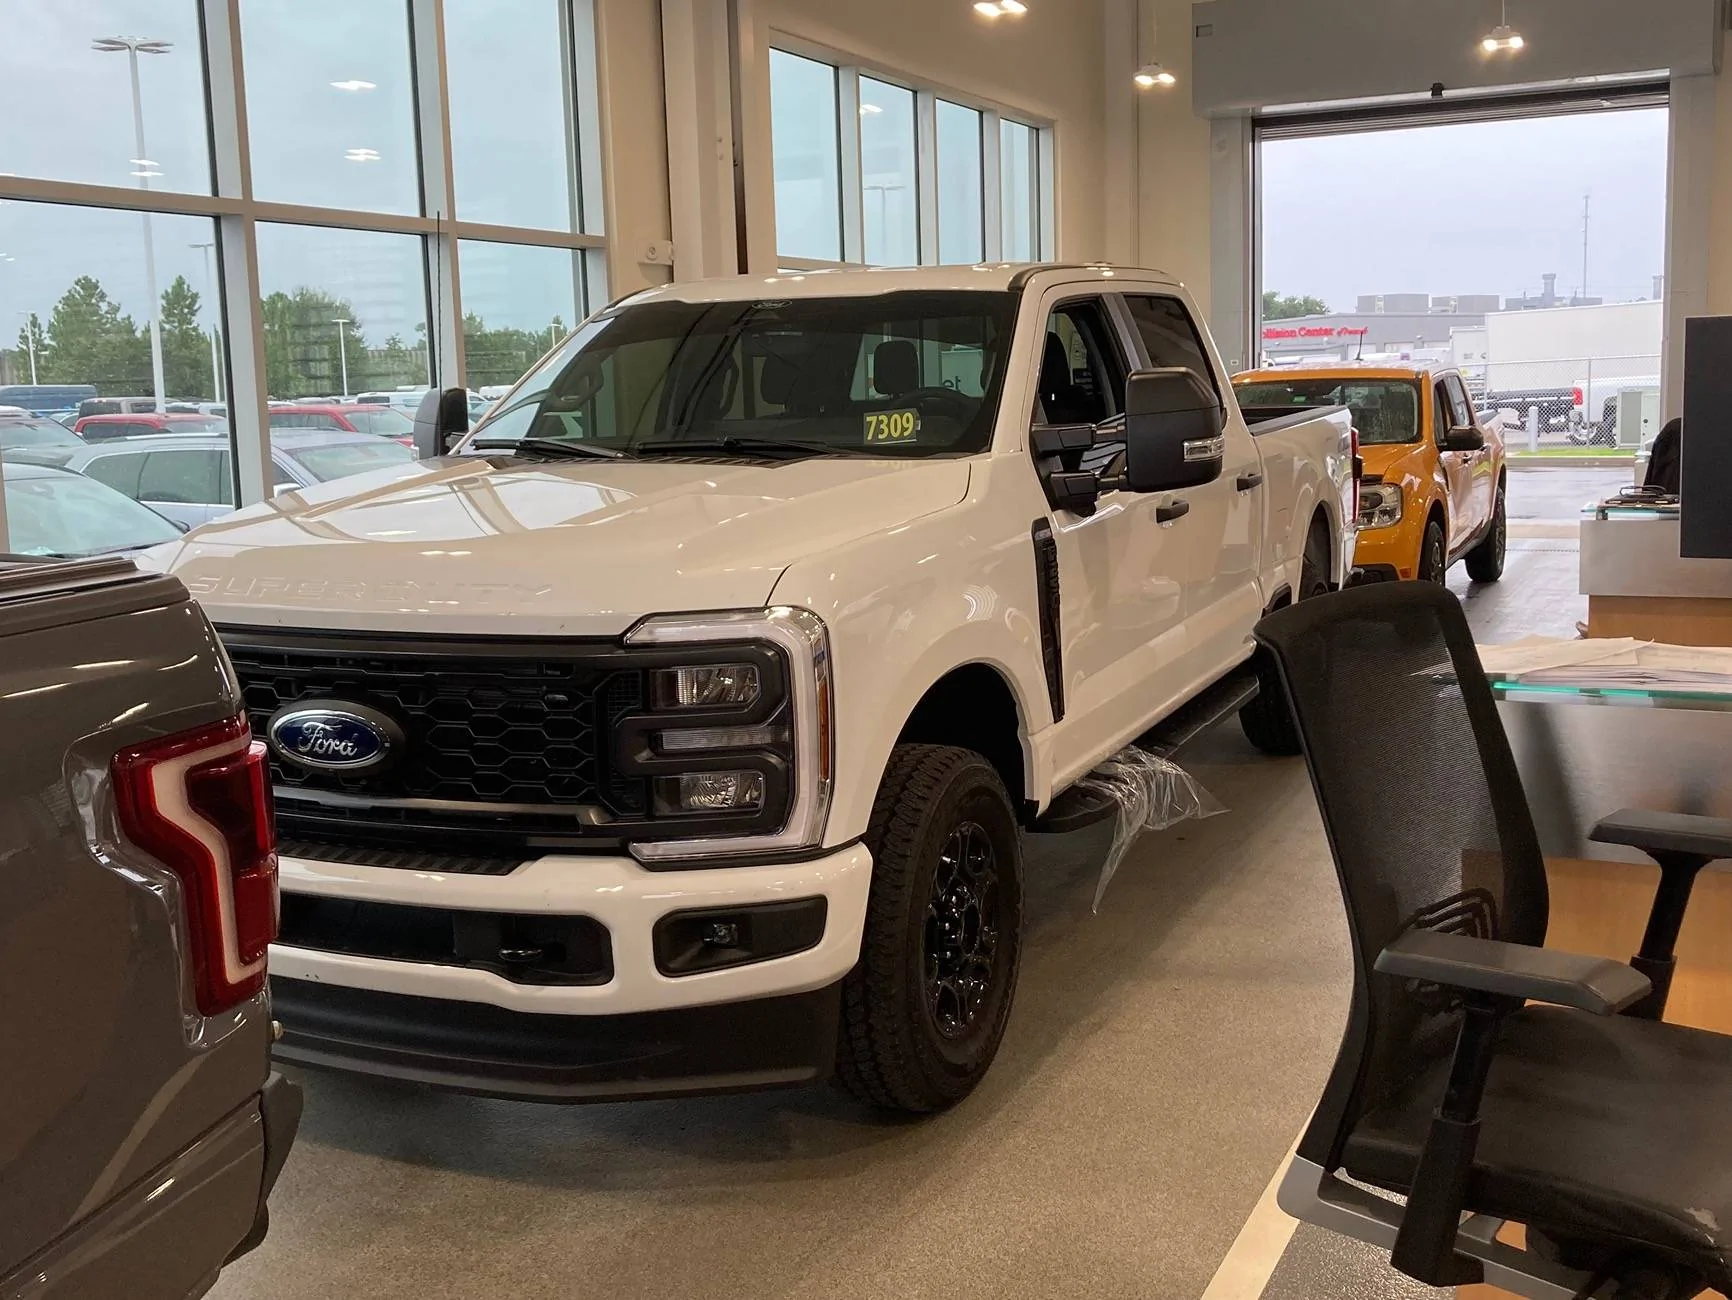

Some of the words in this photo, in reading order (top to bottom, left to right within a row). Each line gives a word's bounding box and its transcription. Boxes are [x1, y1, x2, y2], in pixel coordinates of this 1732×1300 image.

[1298, 326, 1334, 338] Center
[866, 412, 914, 440] 7309
[189, 575, 367, 601] SUPER
[298, 721, 358, 756] Ford
